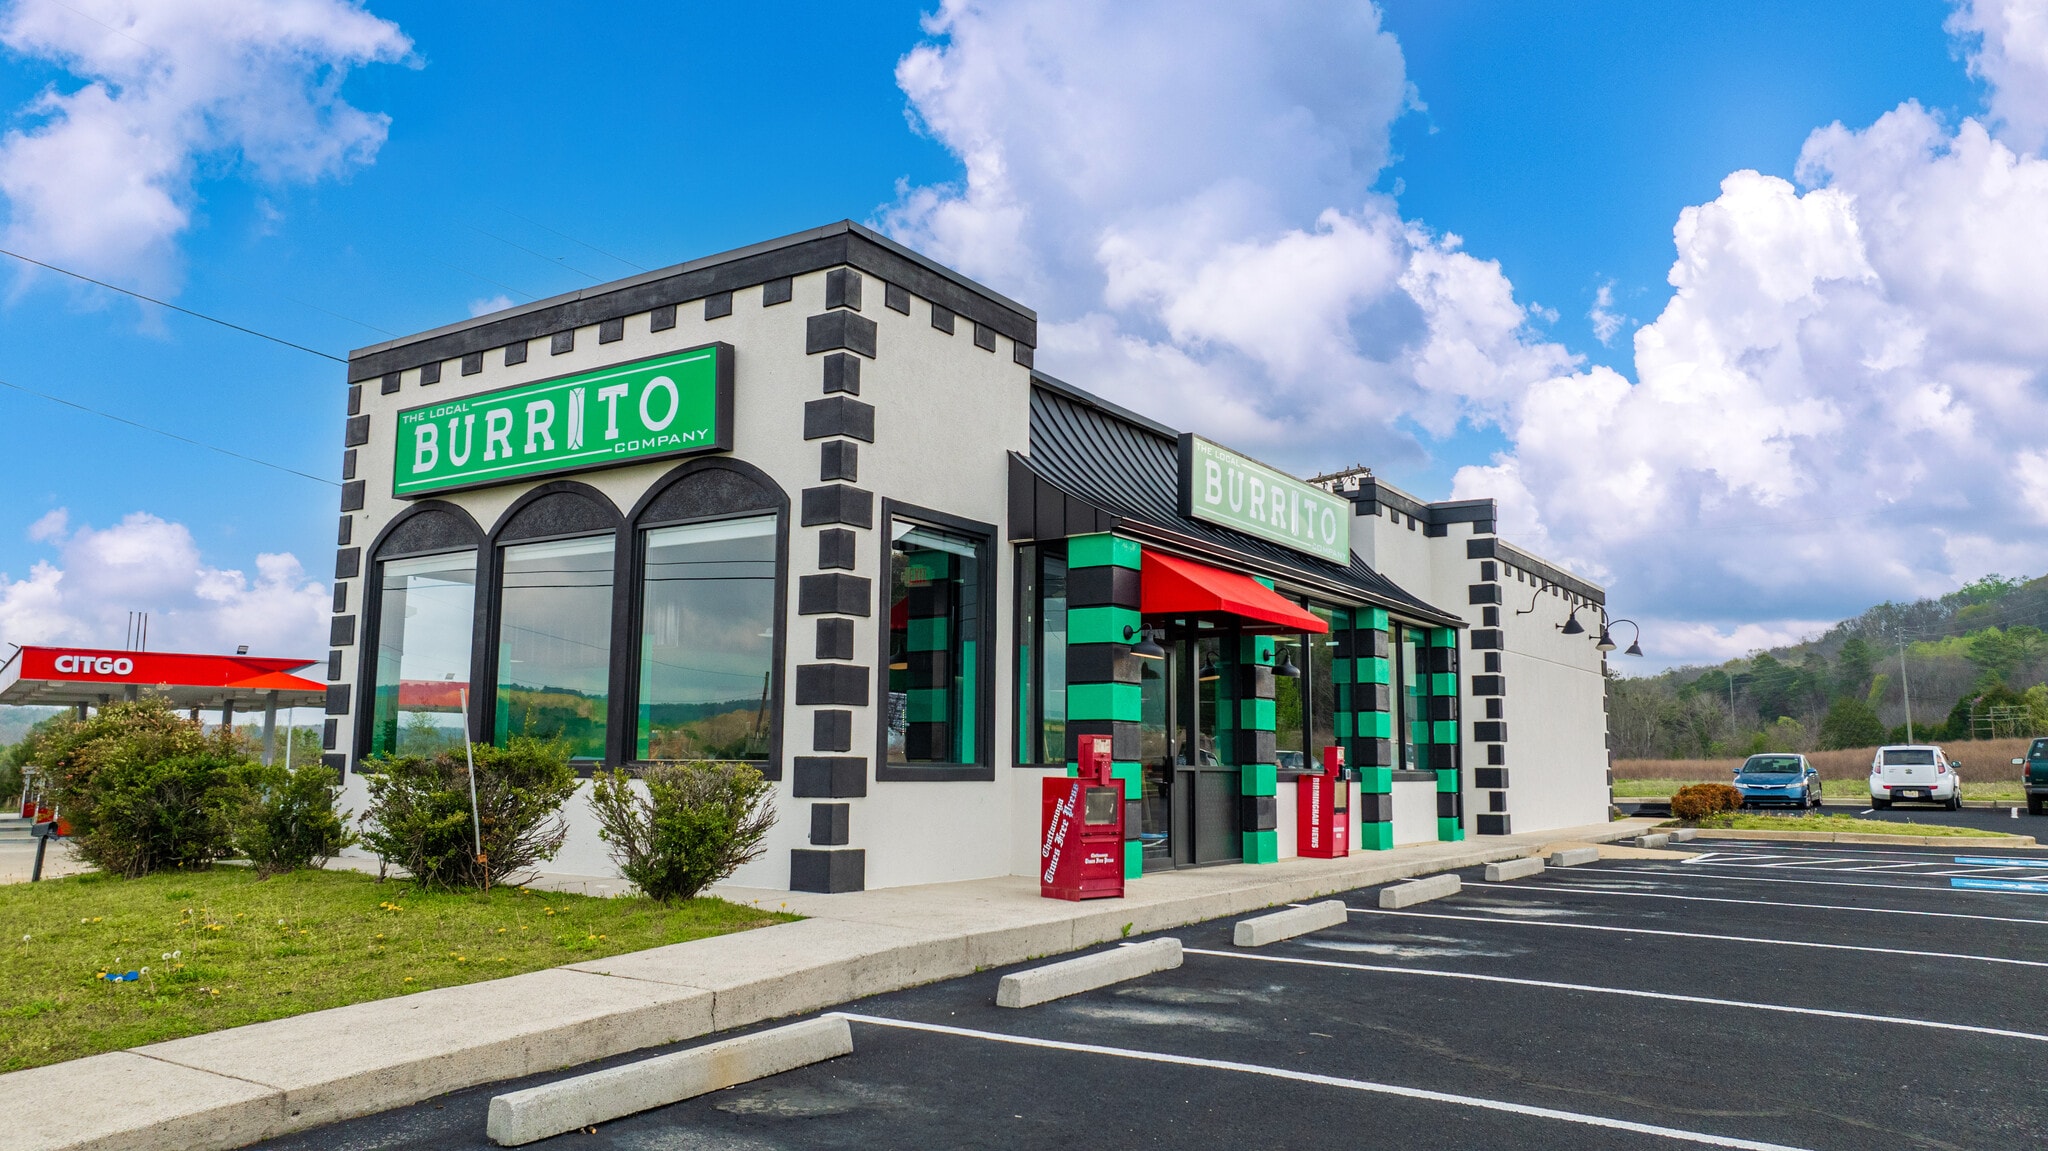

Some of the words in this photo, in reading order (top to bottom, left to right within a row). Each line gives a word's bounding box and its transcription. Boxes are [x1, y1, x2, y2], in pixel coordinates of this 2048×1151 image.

[403, 413, 424, 424] THE
[430, 403, 470, 419] LOCAL
[412, 375, 679, 474] BURRITO
[614, 428, 709, 453] COMPANY
[1197, 443, 1211, 455] THE
[1215, 451, 1240, 467] LOCAL
[1205, 459, 1336, 544] BURRITO
[1312, 543, 1346, 559] COMPANY
[55, 655, 133, 674] CITGO
[1042, 797, 1064, 858] Chattanooga
[1044, 848, 1061, 884] Times
[1054, 819, 1069, 848] Free
[1062, 782, 1079, 818] Press
[1311, 827, 1319, 848] NEWS
